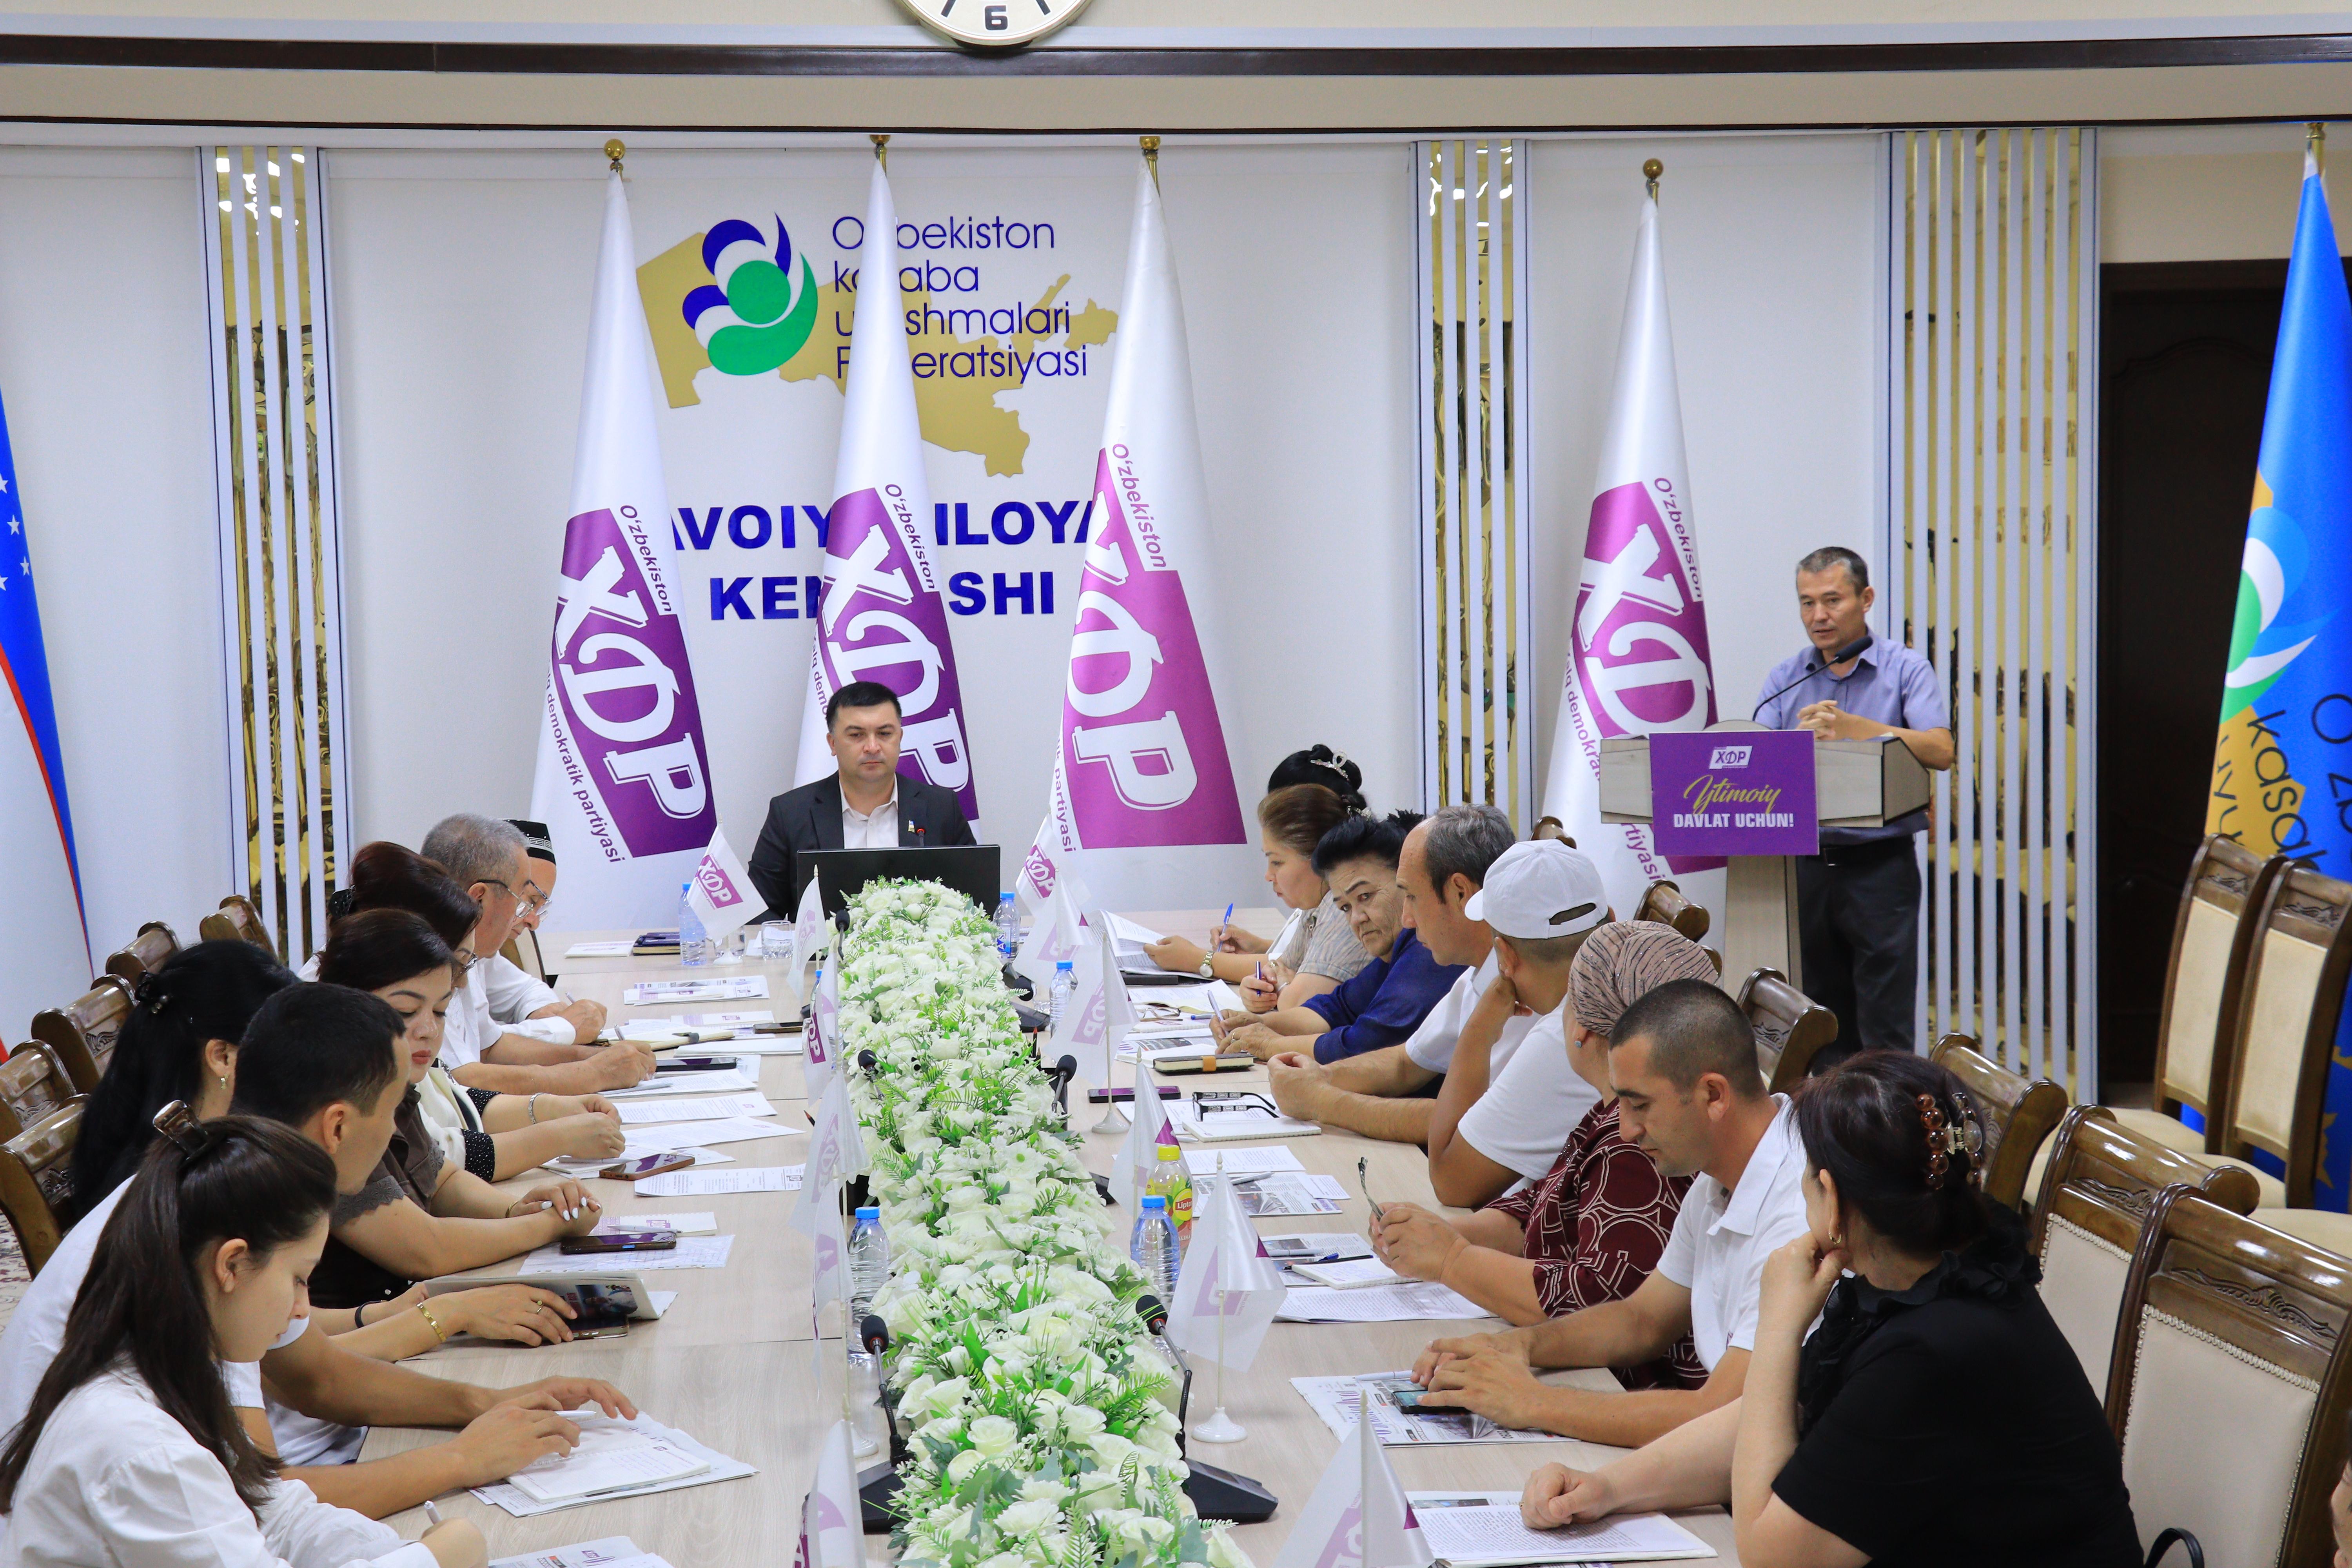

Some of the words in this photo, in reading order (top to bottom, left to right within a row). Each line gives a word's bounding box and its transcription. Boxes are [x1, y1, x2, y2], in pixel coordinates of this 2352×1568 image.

[984, 5, 1008, 31] 6
[833, 216, 1054, 249] Obekiston
[834, 260, 978, 292] kaba
[836, 301, 1069, 337] ushmalari
[837, 344, 1087, 384] Feratsiyasi
[671, 505, 831, 550] VOIY
[935, 501, 1093, 546] ILOY
[1112, 443, 1167, 568] O‘zbekiston
[620, 505, 672, 612] O‘zbekiston
[885, 484, 935, 589] O‘zbekiston
[1654, 477, 1702, 599] O‘zbekiston
[1577, 523, 1711, 734] XD
[555, 545, 707, 819] XDP
[547, 693, 584, 786] demokratik
[573, 789, 626, 863] partiyasi
[1715, 750, 1746, 764] XDP
[1568, 691, 1600, 781] demokra
[1621, 822, 1666, 880] rtiyasi
[1054, 768, 1076, 852] partiyasi
[1673, 813, 1730, 828] DAVLAT
[1735, 813, 1794, 828] UCHUN!
[698, 858, 732, 902] XDP
[808, 1012, 820, 1057] DP
[1178, 1201, 1192, 1210] Lipto
